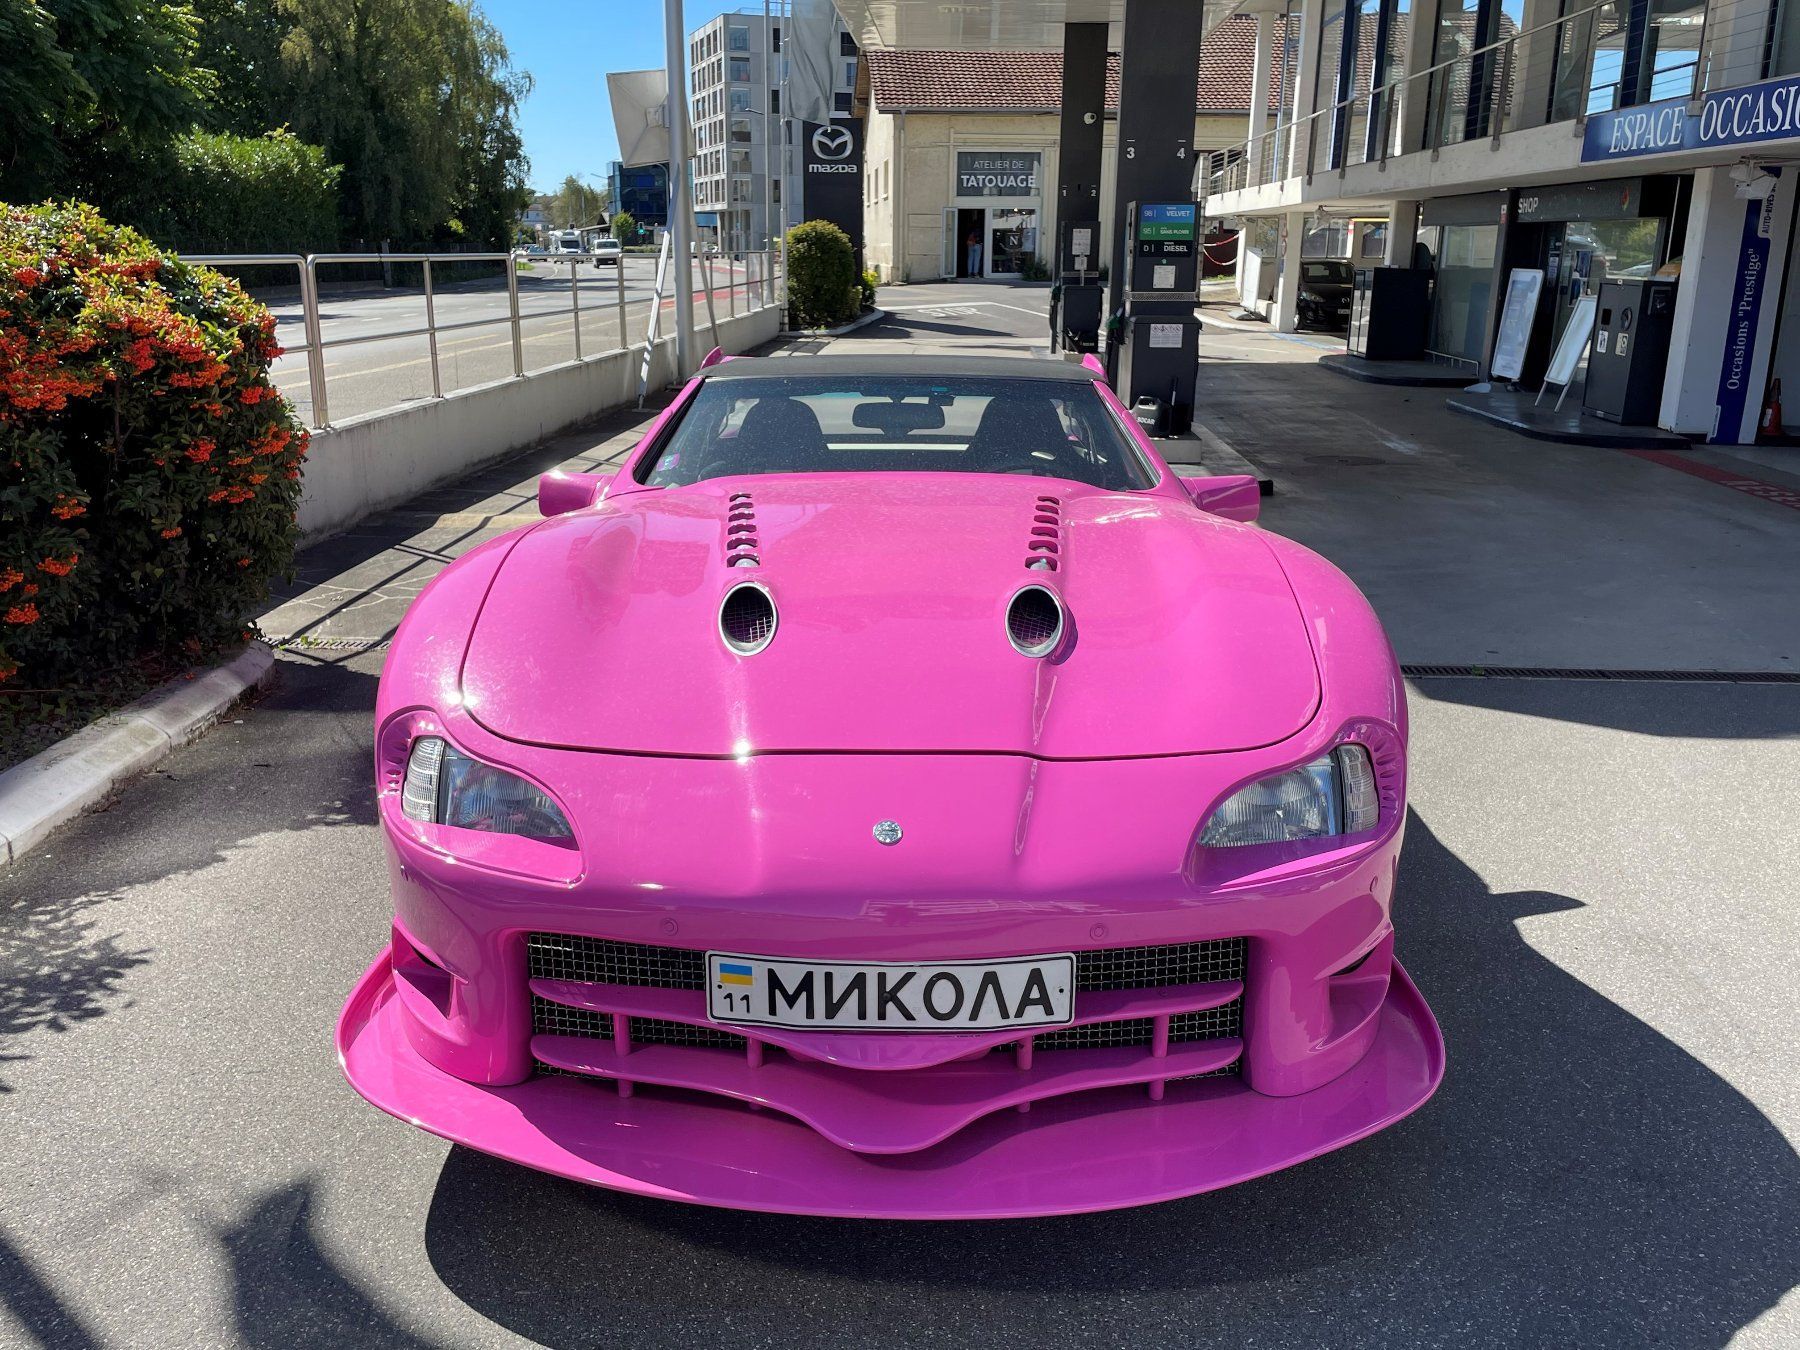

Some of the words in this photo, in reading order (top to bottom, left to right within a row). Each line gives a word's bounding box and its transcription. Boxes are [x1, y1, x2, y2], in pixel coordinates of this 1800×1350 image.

[1609, 106, 1685, 153] ESPACE
[1700, 85, 1800, 141] OCCASI
[1126, 147, 1135, 159] 3
[1177, 147, 1186, 159] 4
[973, 160, 1009, 169] ATELIER
[1012, 160, 1025, 169] DE
[961, 175, 1037, 187] TATOUAGE
[1091, 189, 1097, 197] 2
[1518, 197, 1539, 214] SHOP
[1144, 209, 1153, 217] 98
[1143, 227, 1152, 235] 95
[1009, 236, 1019, 246] N
[1143, 244, 1149, 252] D
[1726, 320, 1749, 390] Occasions
[1738, 248, 1761, 317] "Prestige"
[767, 967, 1055, 1021] МИКОЛА
[723, 992, 750, 1014] 11
